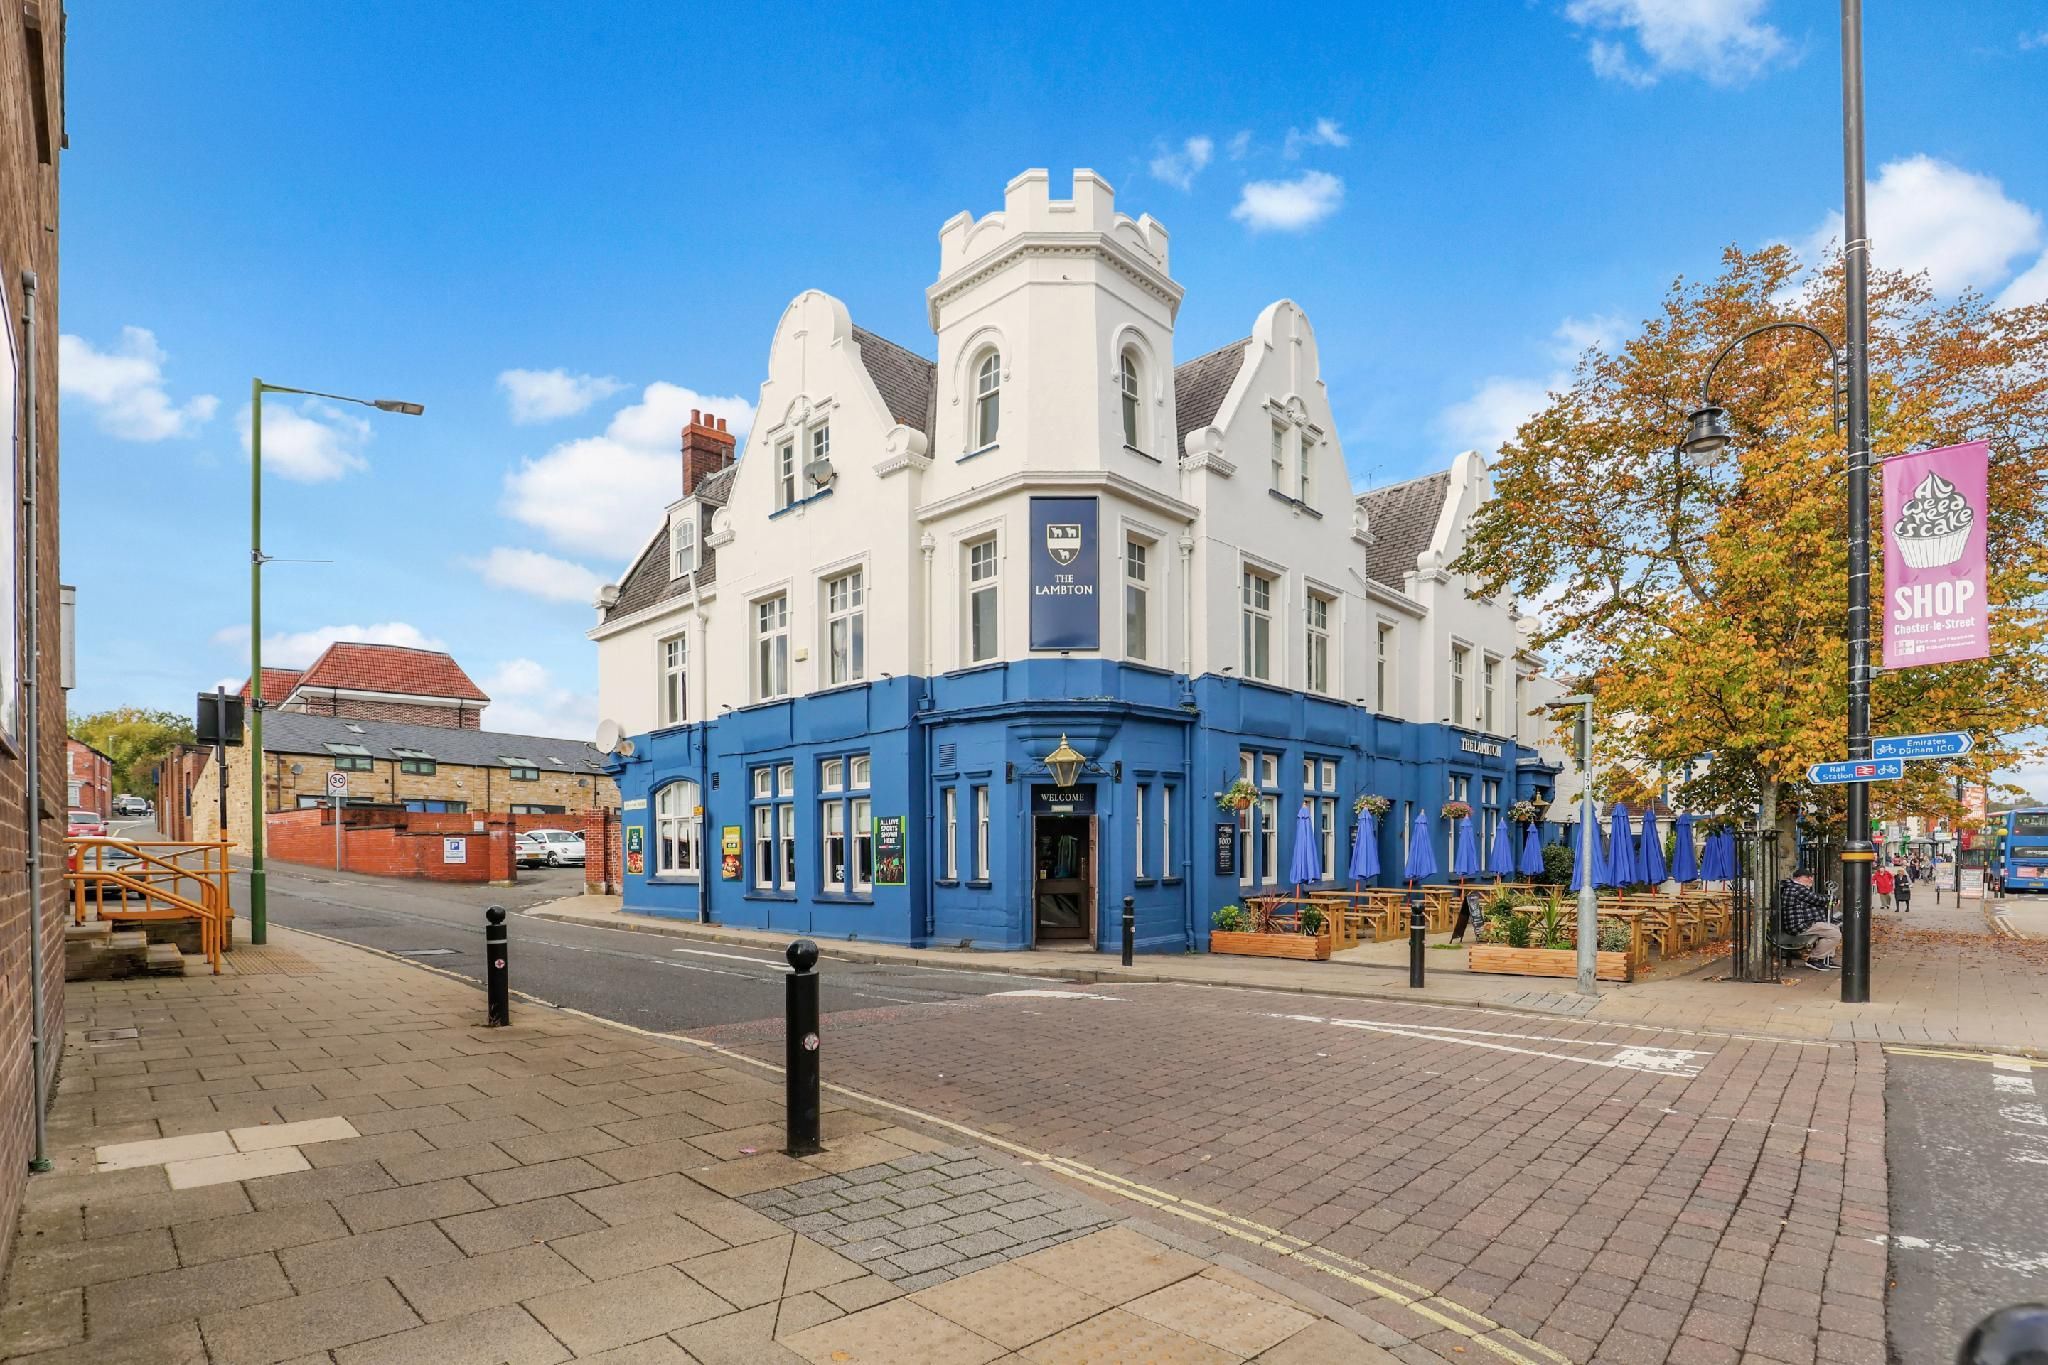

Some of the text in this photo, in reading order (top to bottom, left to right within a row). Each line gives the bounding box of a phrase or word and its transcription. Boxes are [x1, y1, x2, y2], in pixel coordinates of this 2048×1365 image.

[1902, 498, 1937, 516] we
[1913, 494, 1965, 524] need
[1894, 508, 1972, 537] is cake
[1054, 574, 1074, 583] THE
[1035, 585, 1093, 595] LAMBTON
[1893, 580, 1975, 621] SHOP
[1893, 617, 1976, 636] Chester-le-Street
[1461, 737, 1474, 752] THE
[1907, 738, 1947, 747] Emirates
[1937, 744, 1955, 753] ICG
[1829, 765, 1846, 773] Rail
[1822, 772, 1854, 781] Station
[1040, 793, 1085, 802] WELCOME
